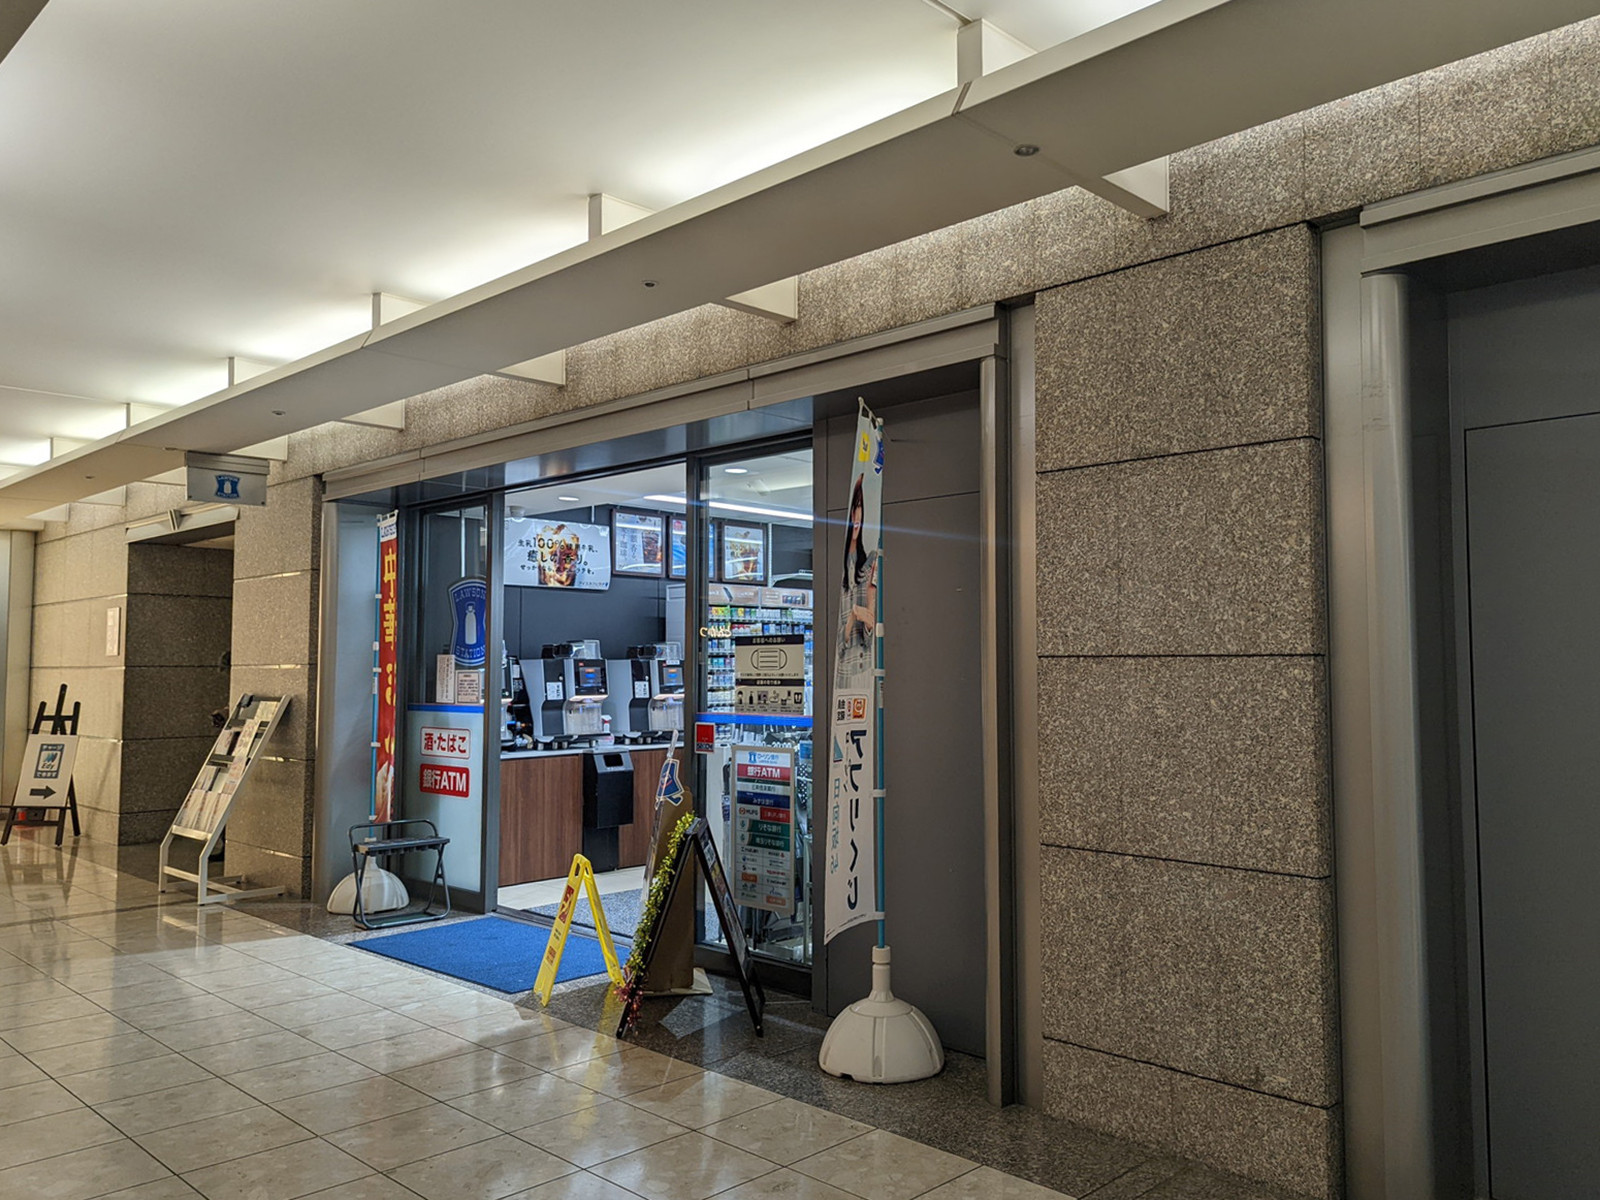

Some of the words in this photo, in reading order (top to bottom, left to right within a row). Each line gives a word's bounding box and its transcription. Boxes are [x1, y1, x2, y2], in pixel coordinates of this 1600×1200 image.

[454, 587, 486, 603] LAWSON
[422, 768, 467, 792] 銀行ATM
[747, 766, 780, 778] 銀行ATM
